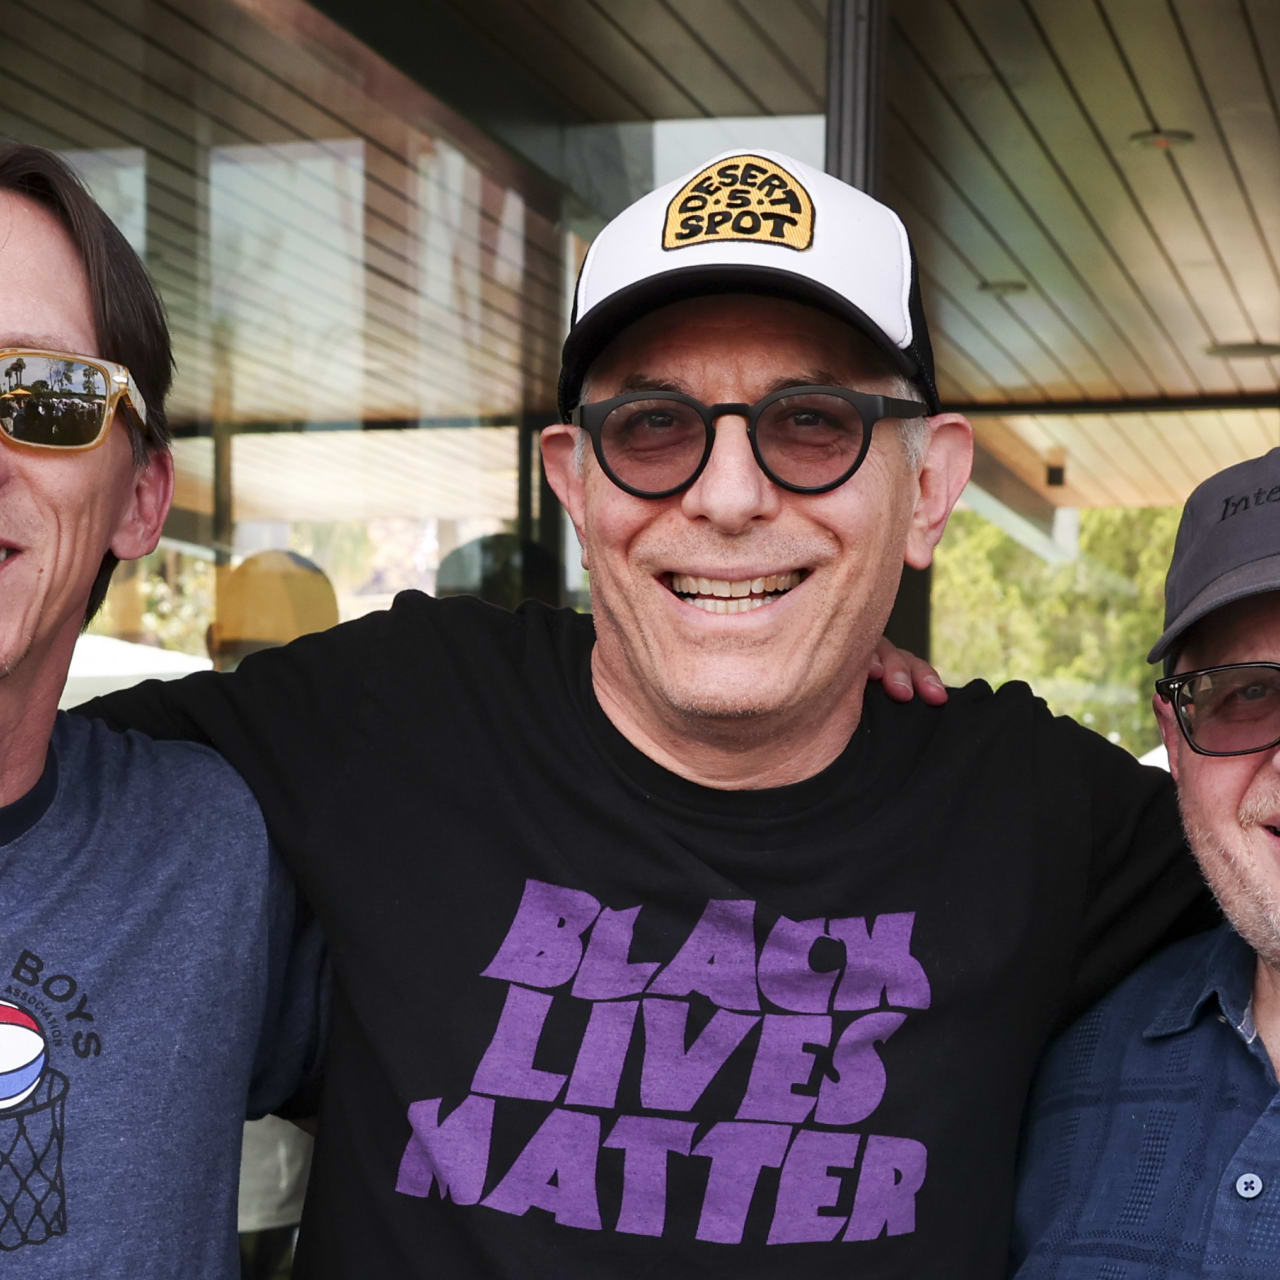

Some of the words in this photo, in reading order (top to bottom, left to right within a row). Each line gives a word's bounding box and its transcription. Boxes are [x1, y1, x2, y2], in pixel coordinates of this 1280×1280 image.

[675, 210, 798, 239] SPOT
[678, 163, 802, 214] DESERT
[479, 878, 931, 1013] BLACK
[4, 984, 64, 1047] ASSOCIATION
[11, 950, 102, 1059] BOYS
[470, 983, 908, 1126] LIVES
[395, 1094, 928, 1245] MATTER
